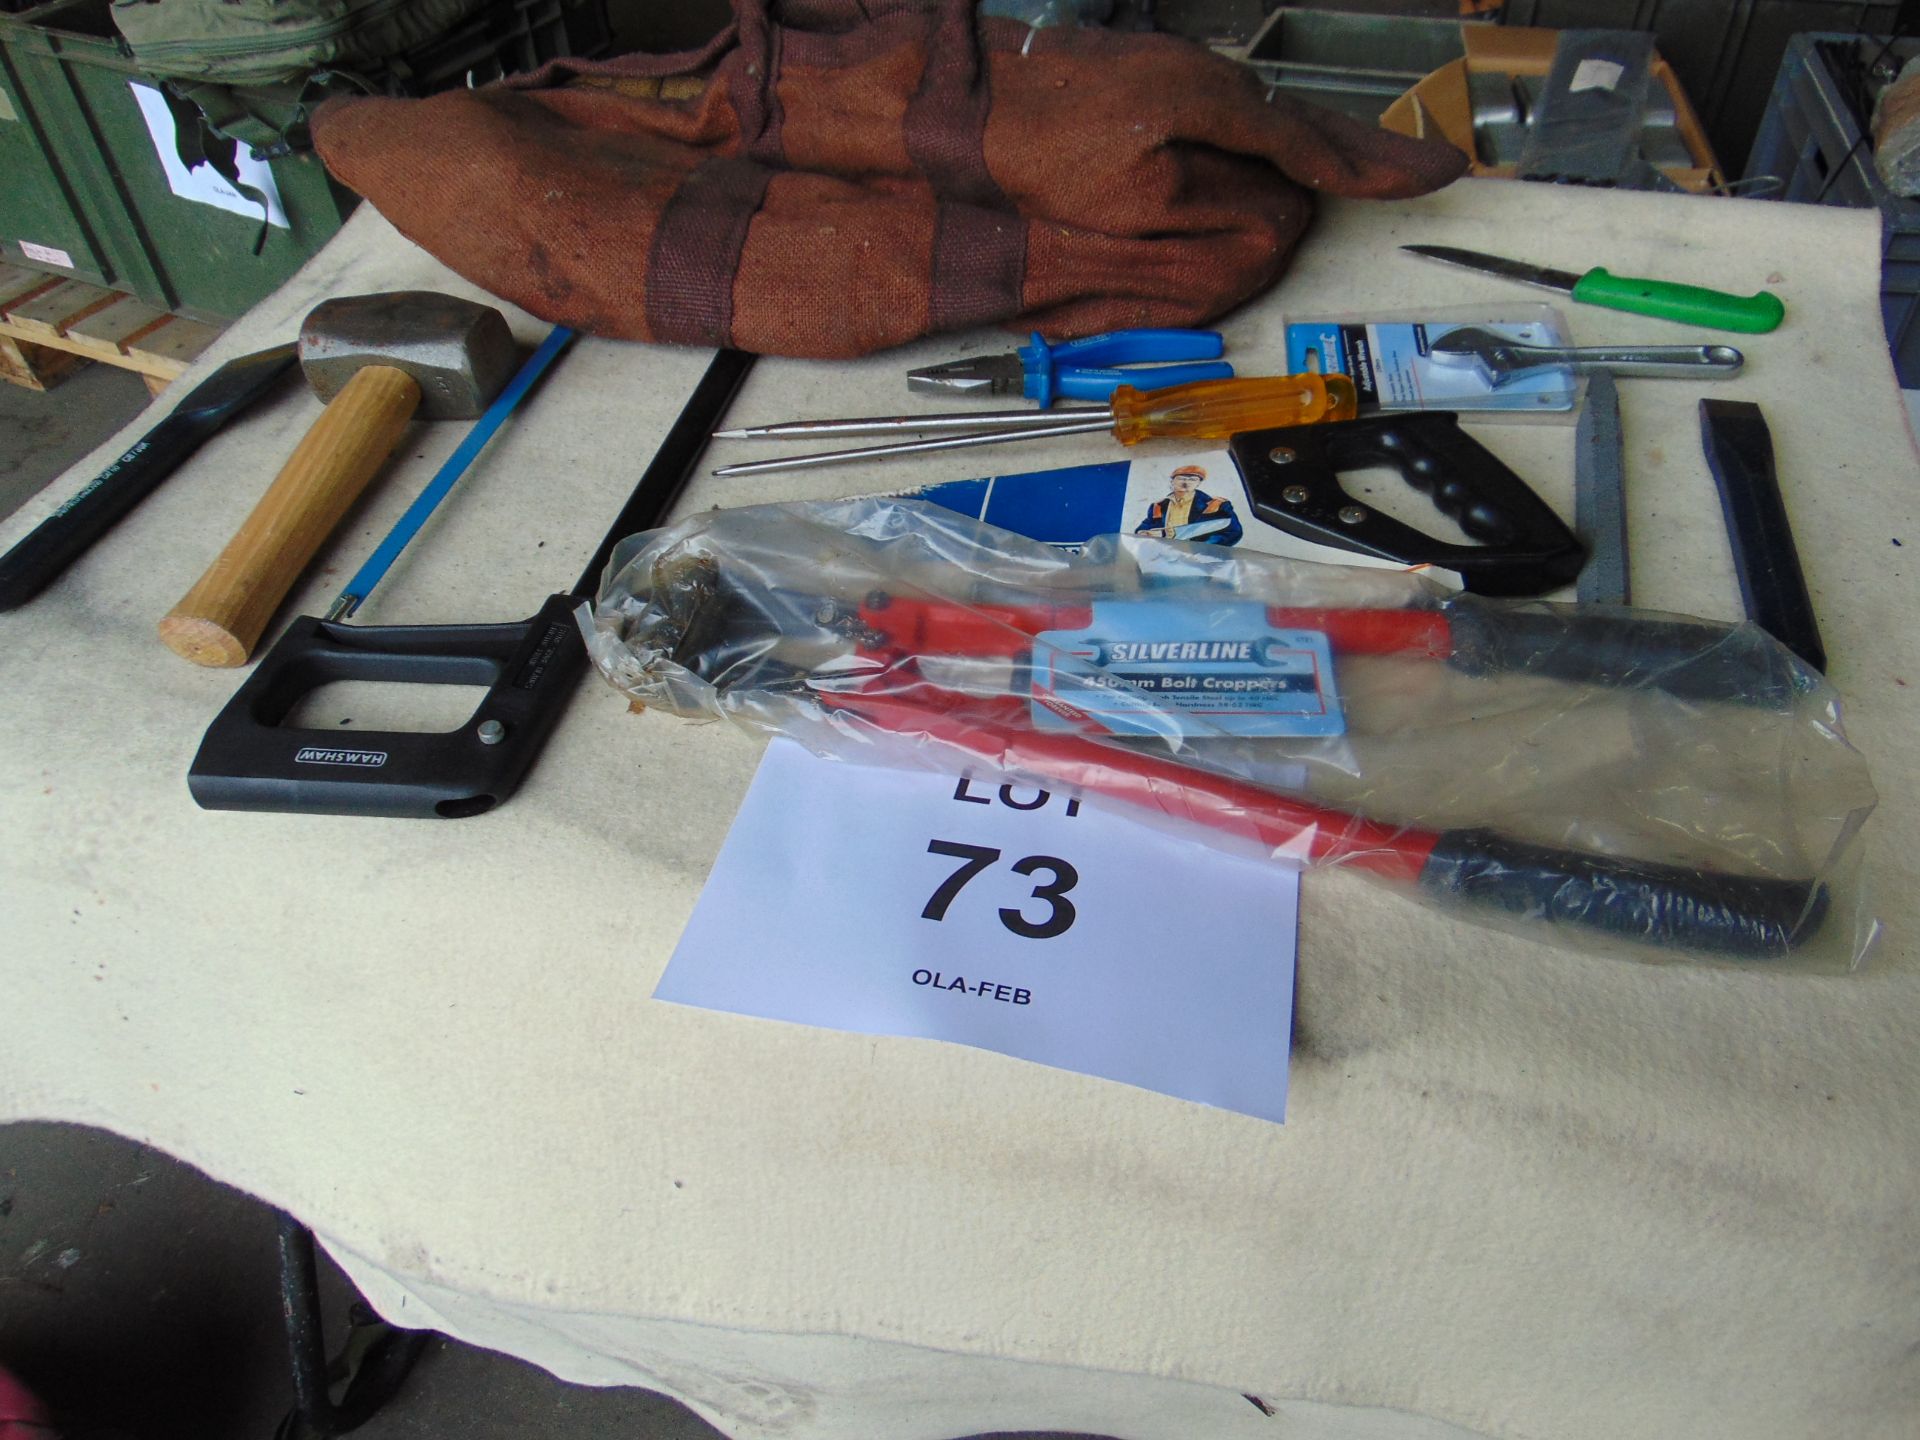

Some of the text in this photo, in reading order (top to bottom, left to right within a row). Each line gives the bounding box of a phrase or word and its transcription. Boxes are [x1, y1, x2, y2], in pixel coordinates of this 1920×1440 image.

[1111, 642, 1251, 660] SILVERLINE
[1161, 677, 1198, 688] Bolt
[1202, 677, 1287, 690] Croppers
[299, 750, 383, 764] HAMSHAW
[921, 839, 1079, 939] 73
[912, 969, 1031, 1005] OLA-FEB
